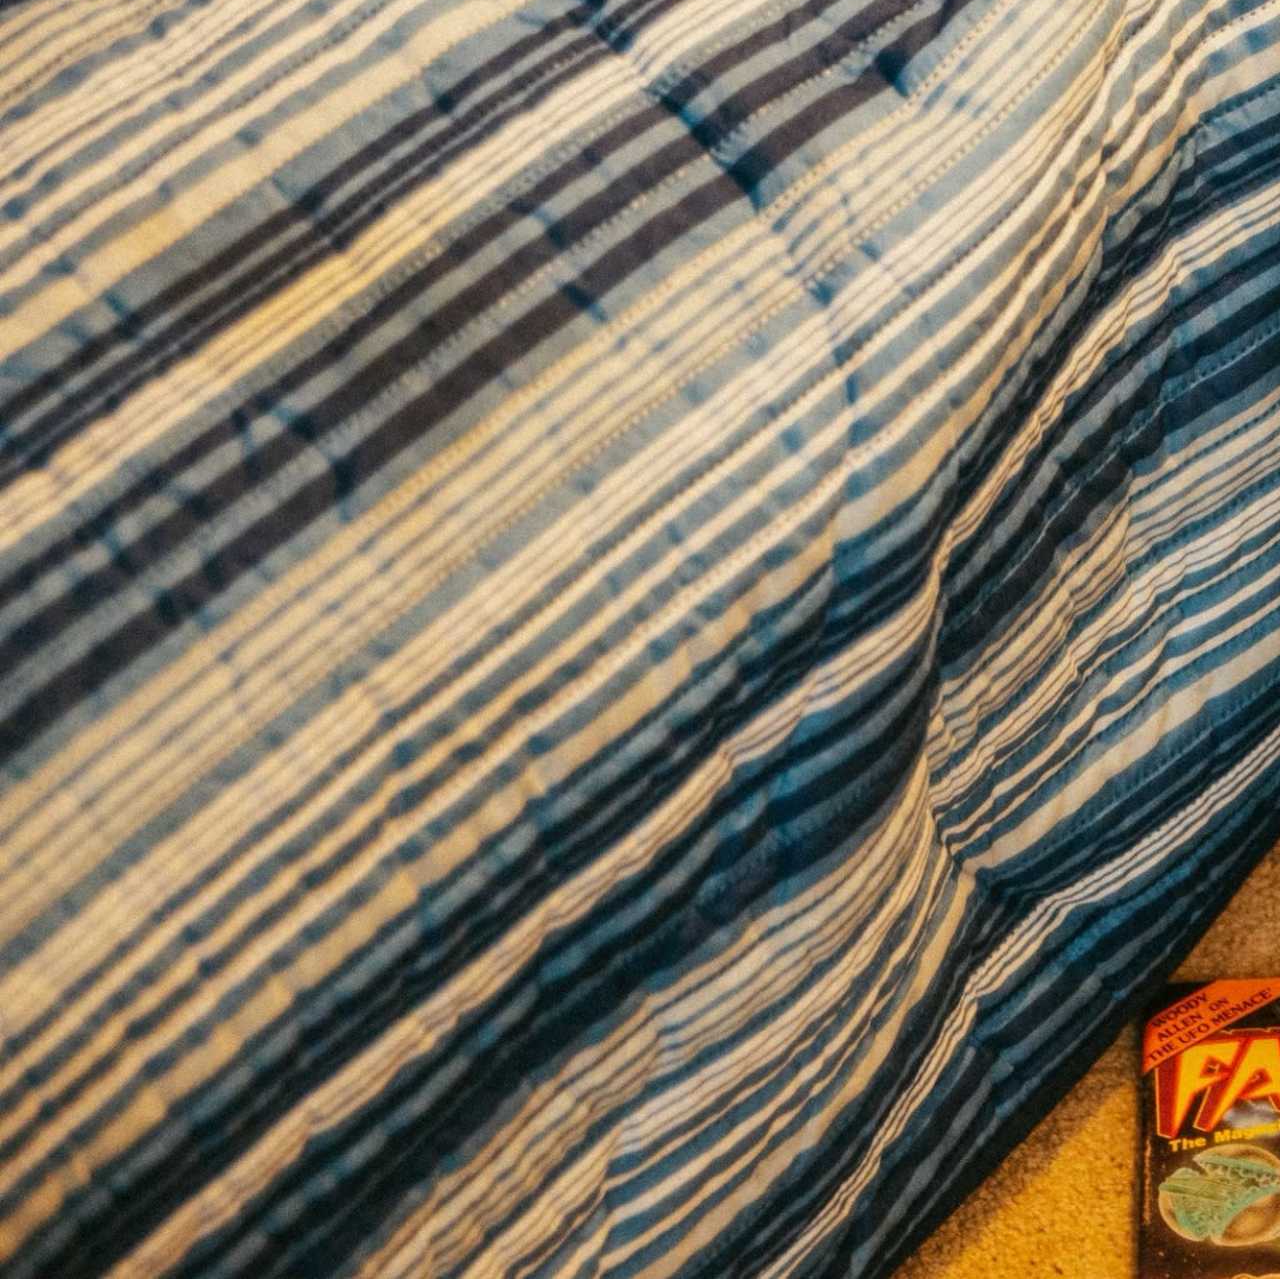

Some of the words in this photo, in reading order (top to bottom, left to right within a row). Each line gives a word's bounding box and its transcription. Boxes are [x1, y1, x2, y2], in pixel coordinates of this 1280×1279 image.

[1151, 991, 1208, 1028] WOODY
[1156, 1013, 1203, 1043] ALLEN
[1208, 996, 1230, 1013] ON
[1149, 1041, 1178, 1062] THE
[1178, 1022, 1210, 1045] UFO
[1168, 1136, 1207, 1153] The
